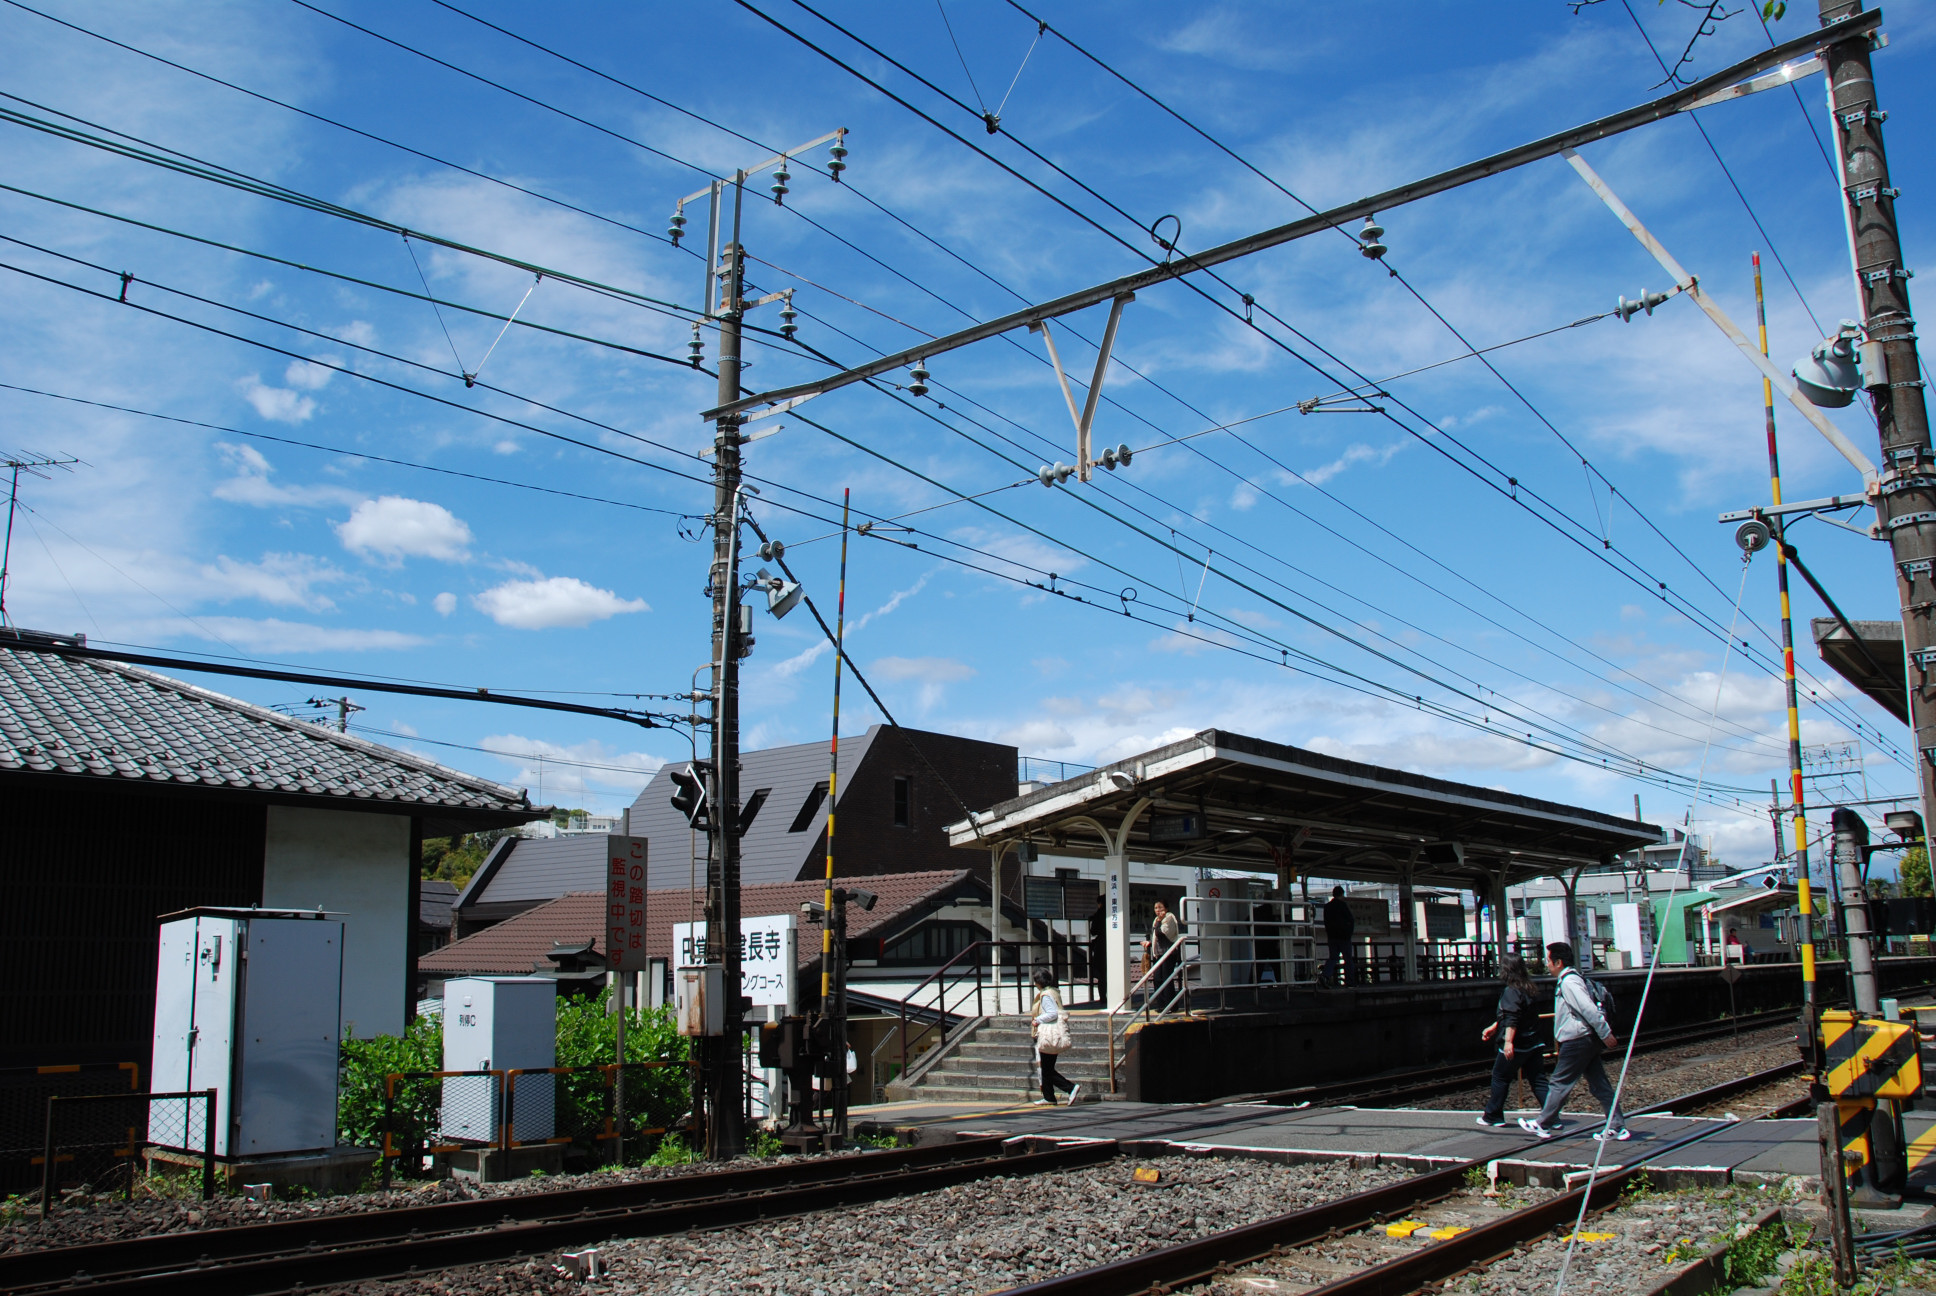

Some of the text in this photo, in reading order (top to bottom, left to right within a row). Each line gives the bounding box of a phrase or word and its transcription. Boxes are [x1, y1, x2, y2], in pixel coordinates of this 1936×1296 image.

[610, 857, 626, 966] 監視中です
[629, 842, 644, 949] この踏切は
